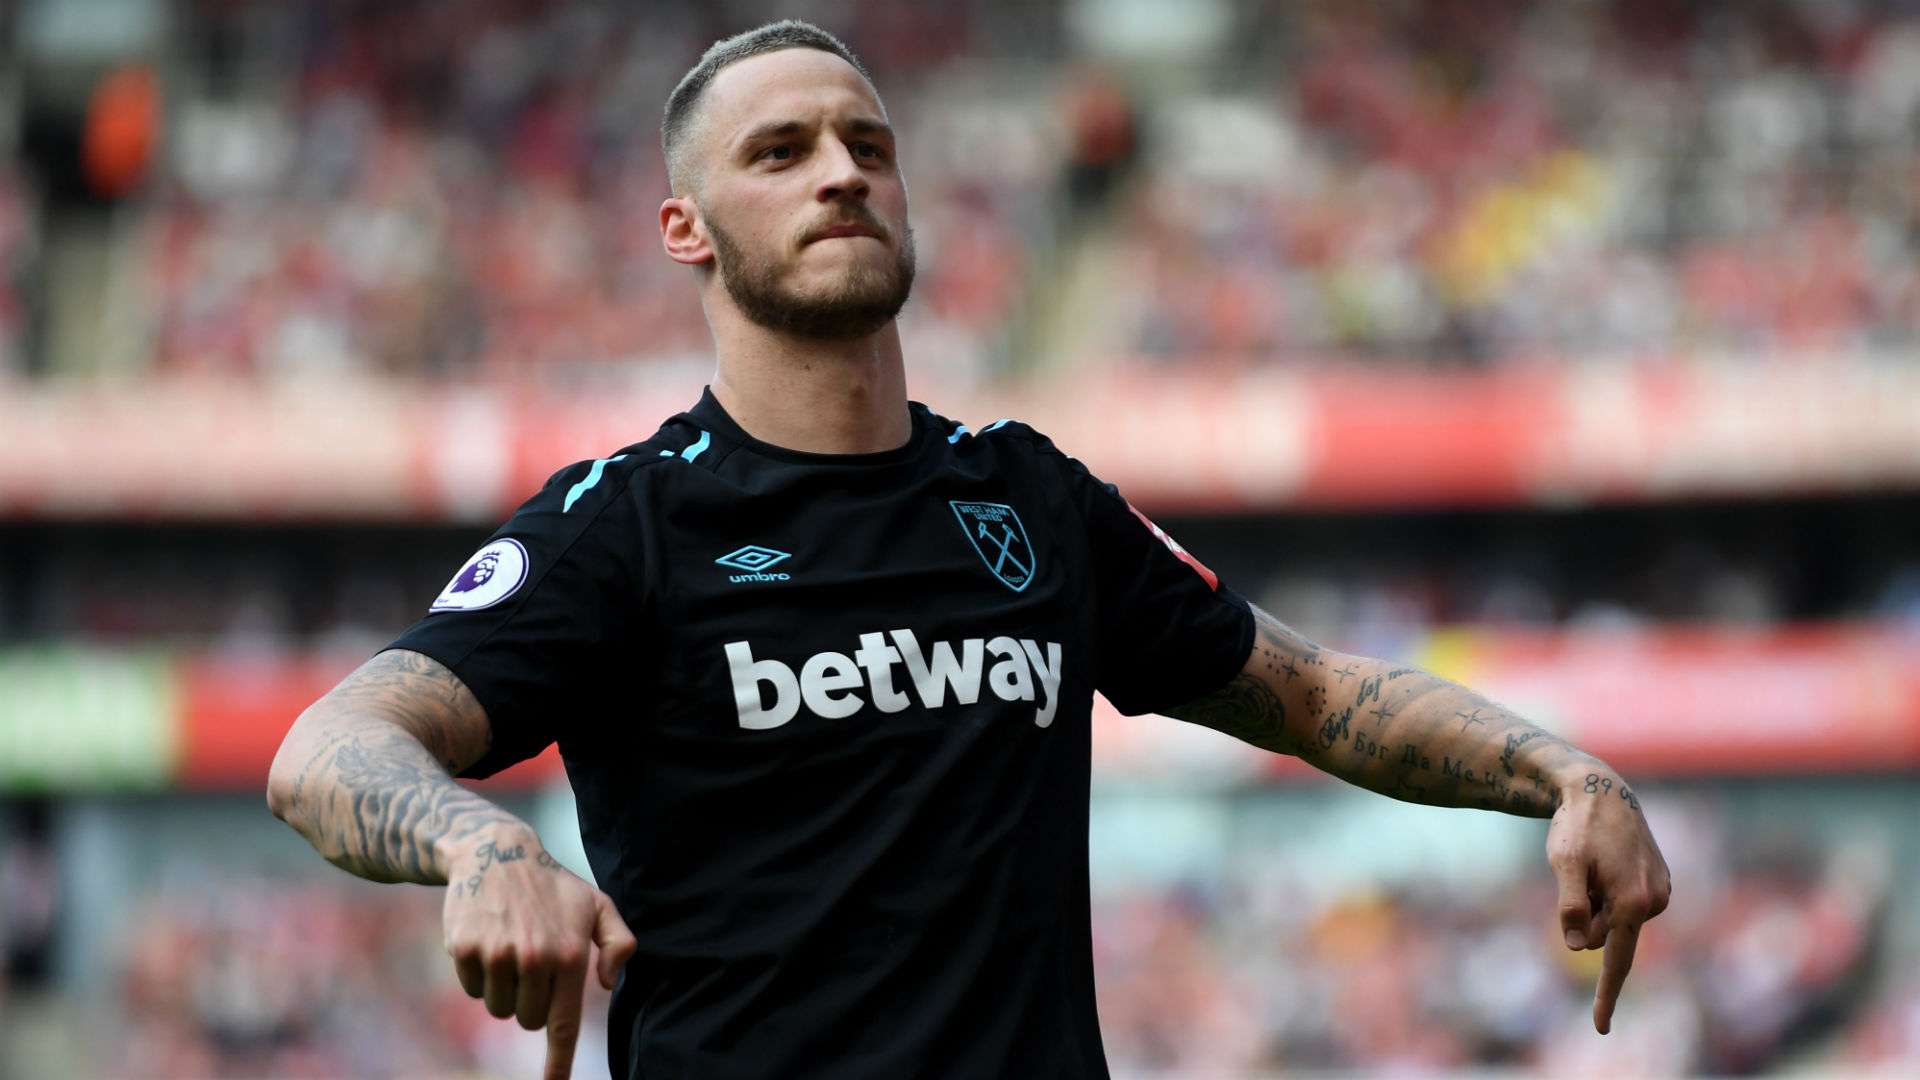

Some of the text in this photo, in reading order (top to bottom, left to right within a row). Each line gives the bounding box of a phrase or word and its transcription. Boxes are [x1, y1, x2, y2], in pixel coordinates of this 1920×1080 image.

[728, 572, 791, 583] umbro
[724, 628, 1062, 730] betway
[1584, 773, 1613, 796] 89
